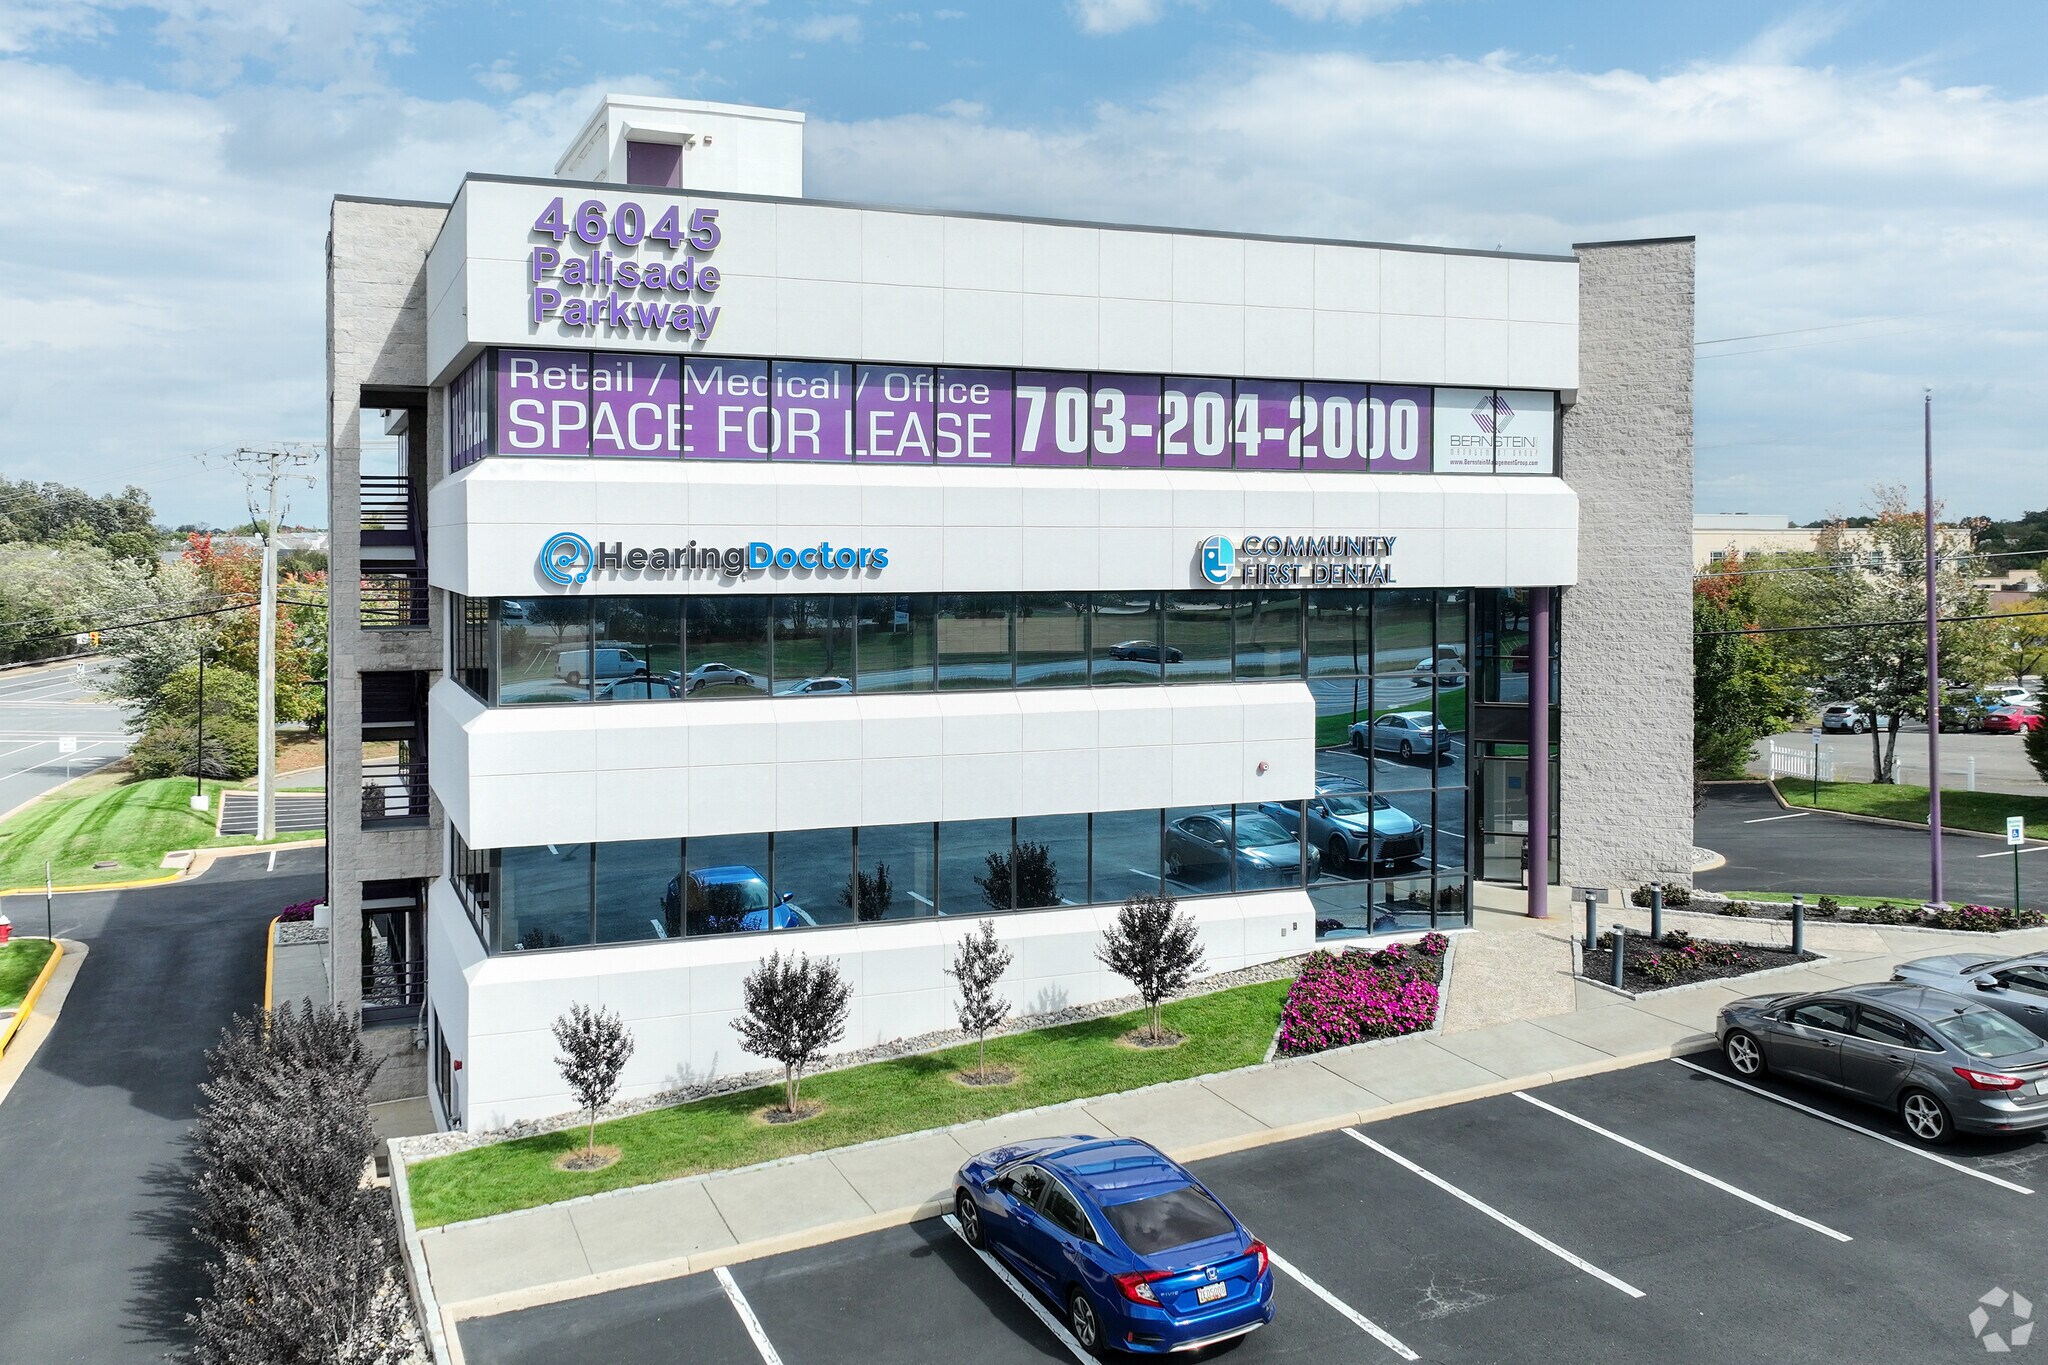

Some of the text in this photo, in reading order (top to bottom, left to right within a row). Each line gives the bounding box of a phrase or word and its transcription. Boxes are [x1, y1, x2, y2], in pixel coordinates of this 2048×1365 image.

[533, 197, 722, 252] 46045
[532, 246, 722, 293] Palisade
[533, 287, 722, 341] Parkway
[510, 357, 633, 392] Retail
[648, 363, 667, 397] /
[855, 371, 870, 402] /
[884, 372, 990, 405] Office
[508, 398, 695, 452] SPACE
[718, 405, 821, 455] FOR
[844, 409, 992, 458] LEASE
[1016, 385, 1419, 461] 703-204-2000
[1450, 434, 1536, 448] BERNSTEIN
[1450, 458, 1538, 467] www.BernsteinMaagementGroup.com
[597, 539, 889, 578] HearingDoctors
[1243, 535, 1397, 557] COMMUNITY
[1243, 563, 1397, 585] FIRST DENTAL
